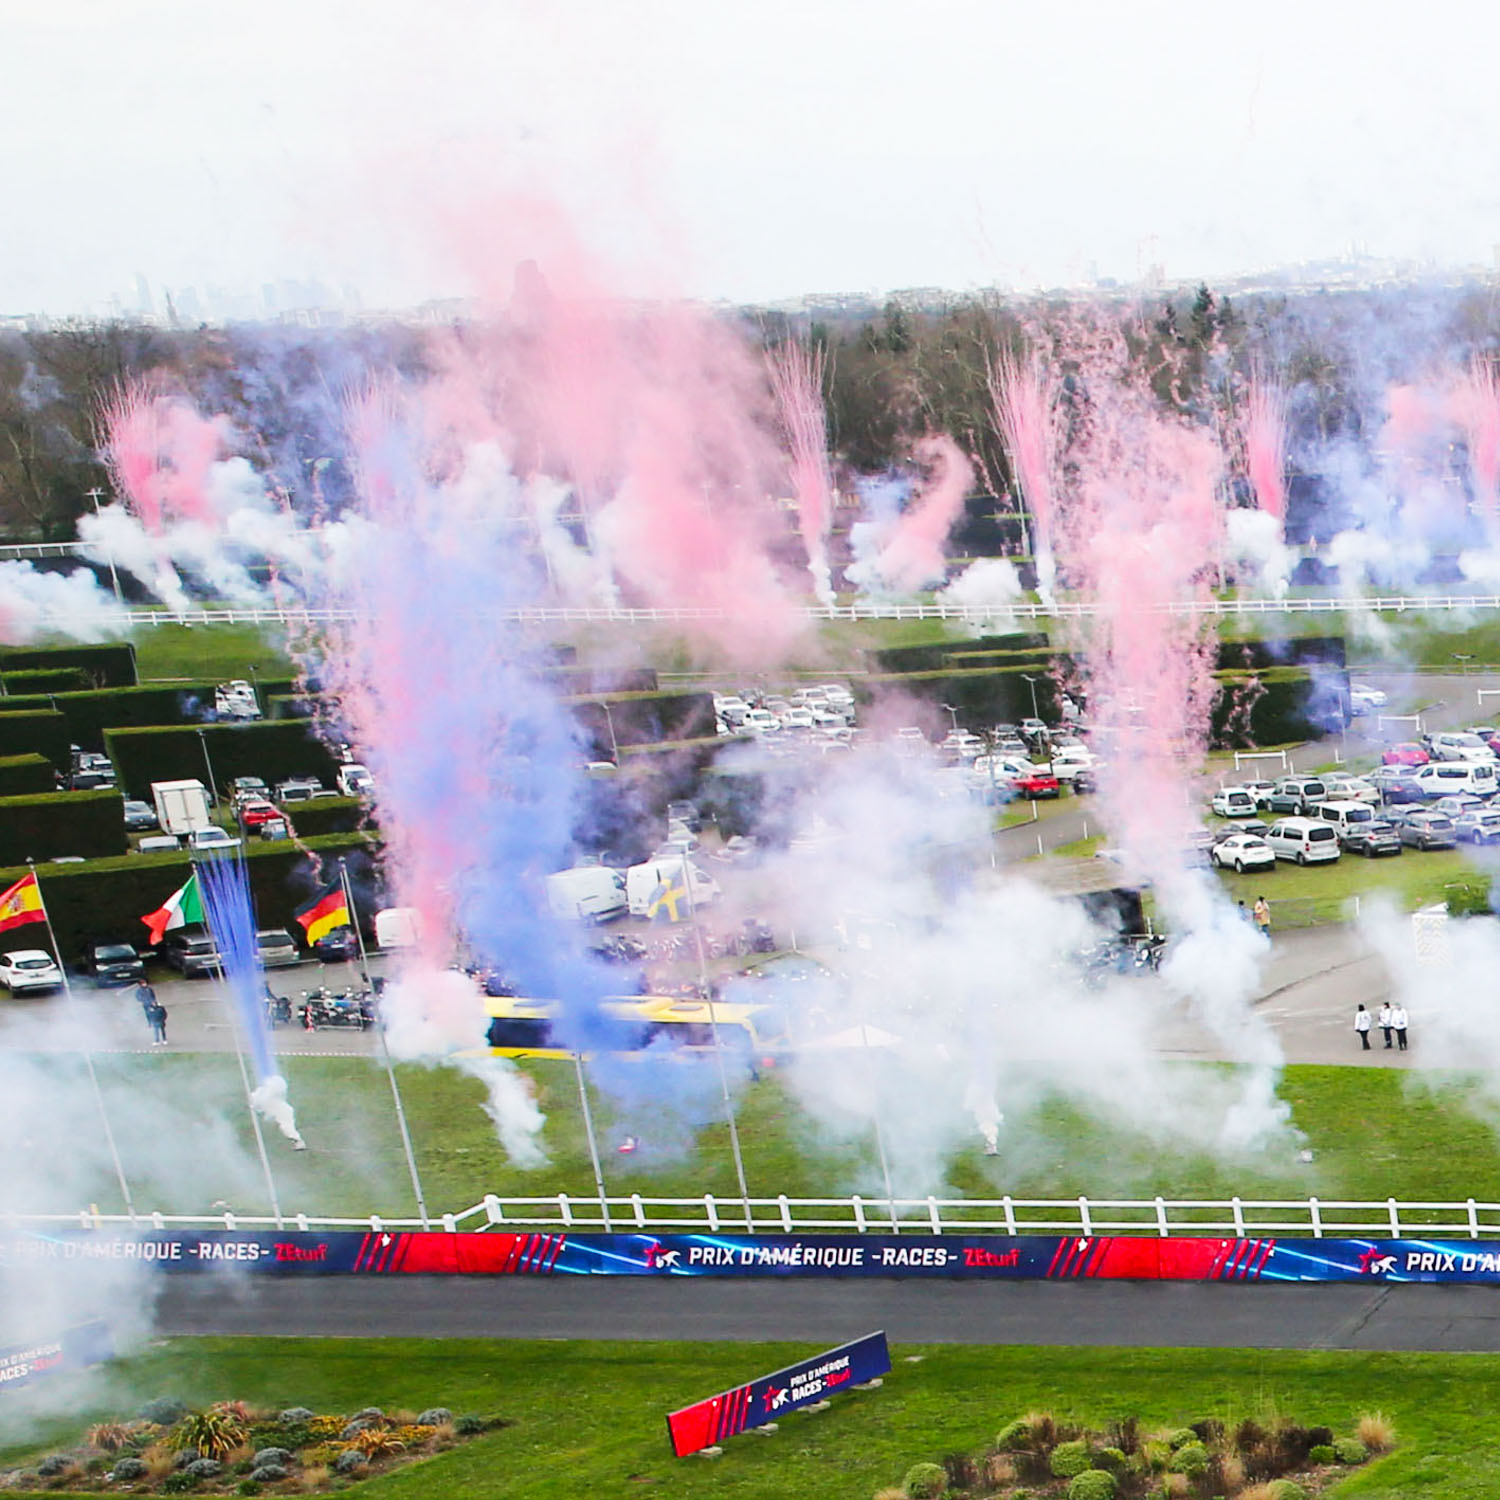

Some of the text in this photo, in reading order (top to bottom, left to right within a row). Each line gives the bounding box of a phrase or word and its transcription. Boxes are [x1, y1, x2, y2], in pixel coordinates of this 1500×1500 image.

[274, 1243, 328, 1262] ZEturf
[689, 1248, 735, 1265] PRIX
[742, 1243, 864, 1268] D'AMÉRIQUE
[963, 1248, 1019, 1267] ZEturf
[1406, 1252, 1456, 1271] PRIX
